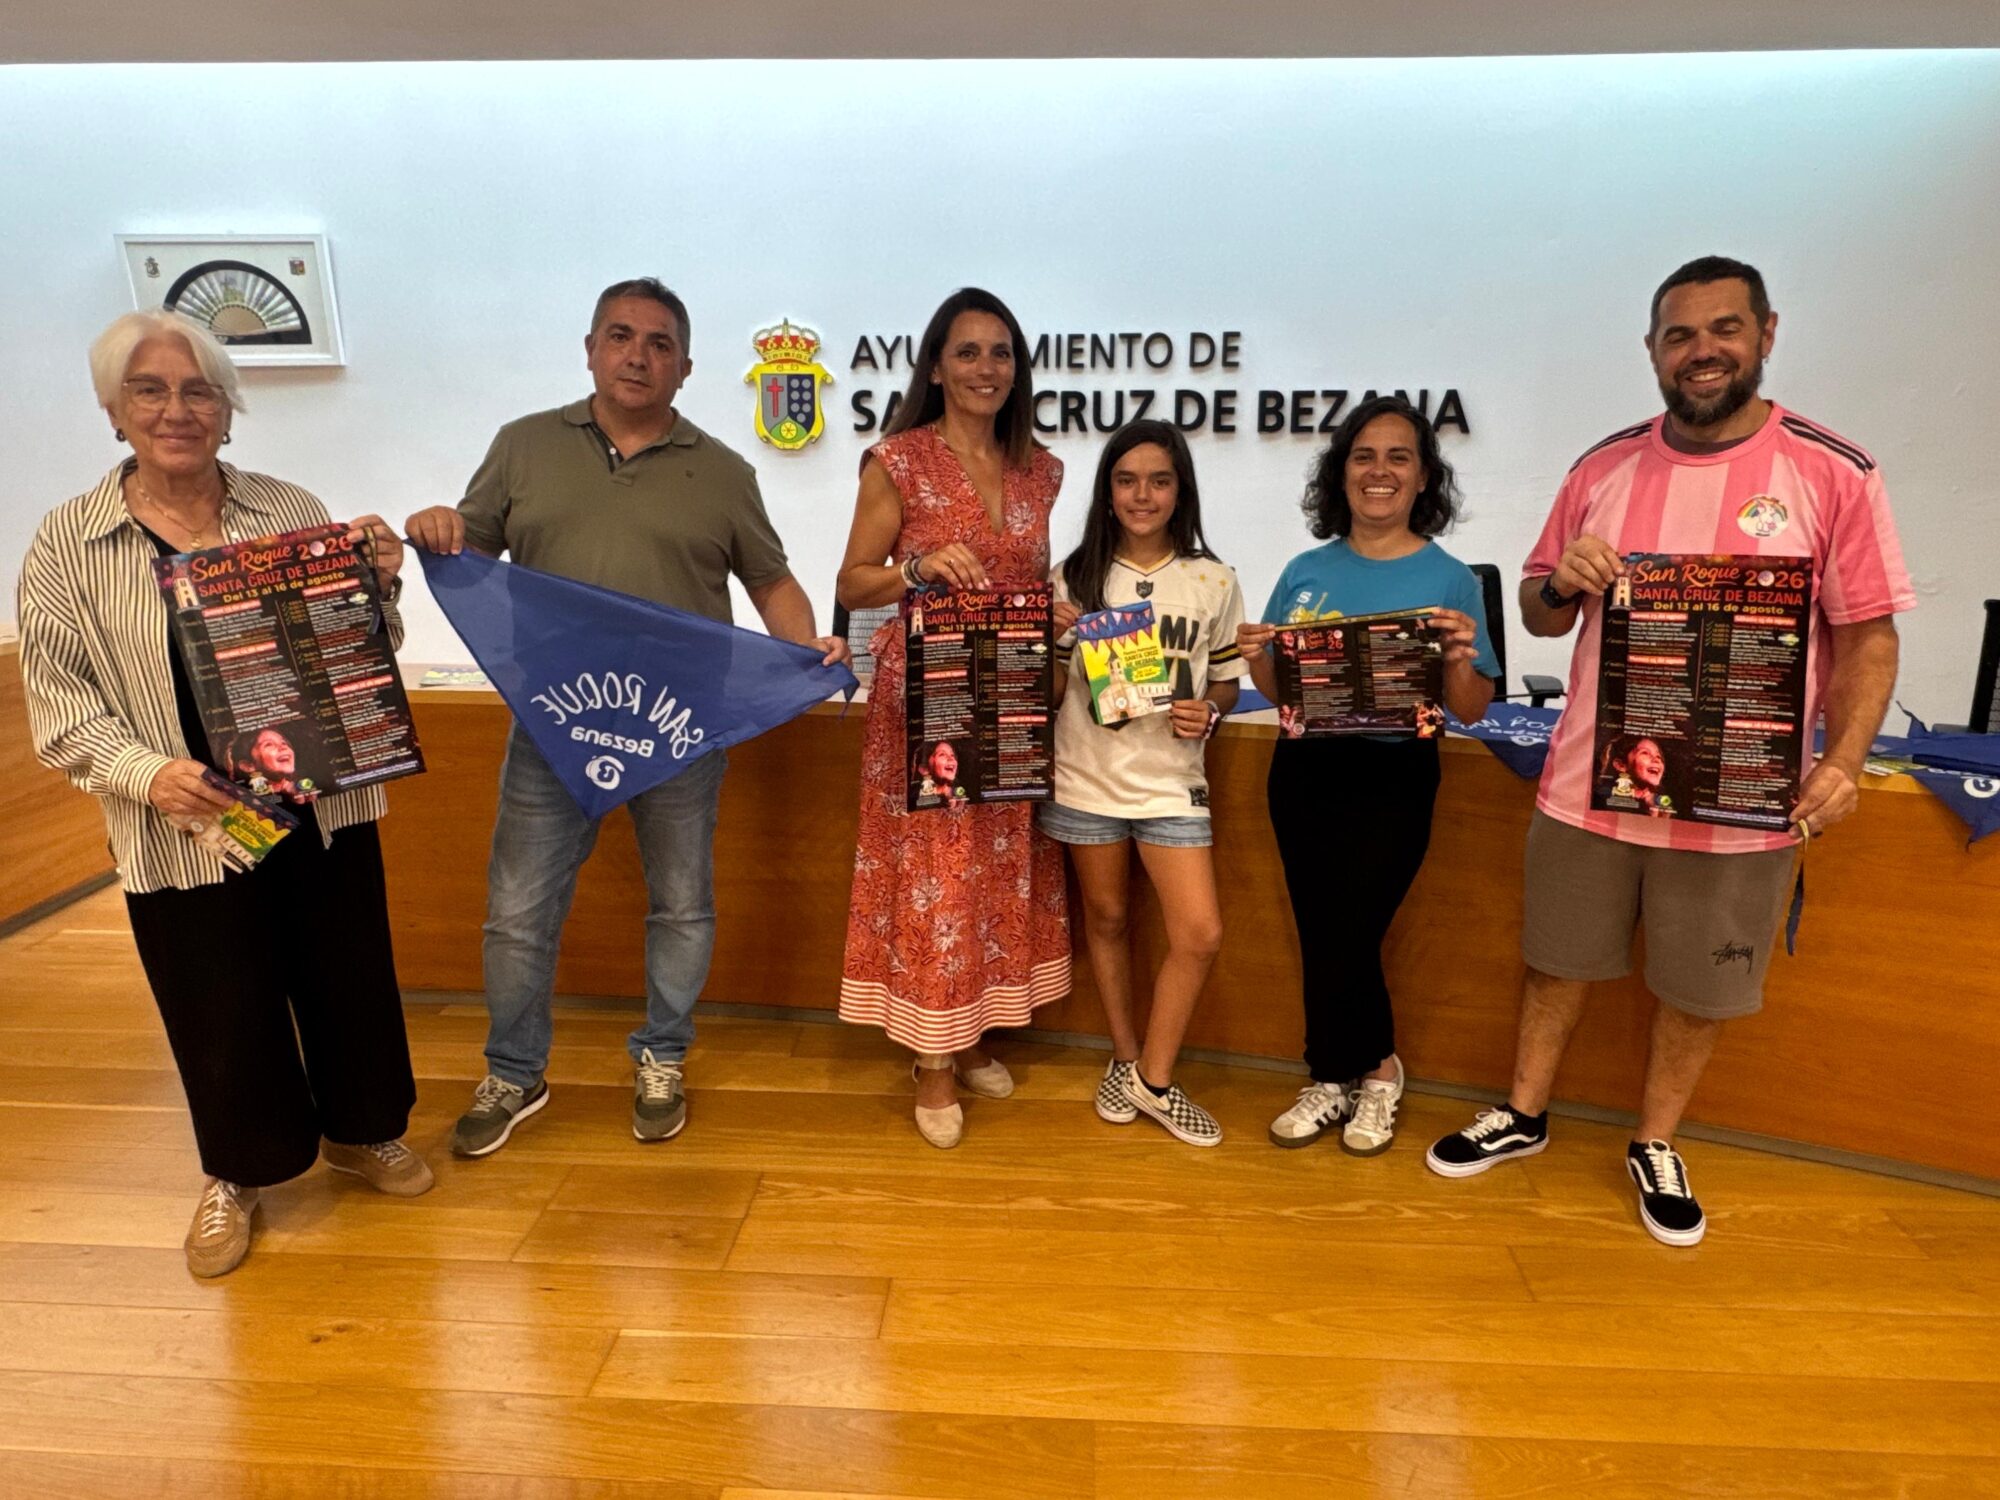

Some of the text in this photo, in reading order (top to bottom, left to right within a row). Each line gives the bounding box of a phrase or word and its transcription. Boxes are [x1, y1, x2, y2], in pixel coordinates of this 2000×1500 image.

[850, 331, 1241, 370] AYUMIENTO DE
[1032, 389, 1470, 434] CRUZ DE BEZNA
[191, 557, 236, 582] San
[237, 546, 294, 574] Roque
[199, 578, 245, 598] SANTA
[248, 570, 284, 587] CRUZ
[287, 566, 305, 580] DE
[307, 554, 359, 576] BEZANA
[1632, 560, 1805, 589] San Roque 2026
[223, 591, 243, 603] Del
[247, 588, 259, 598] 13
[261, 585, 272, 596] al
[274, 582, 287, 593] 16
[290, 579, 304, 589] de
[307, 571, 345, 586] agosto
[923, 591, 1048, 612] San Roque 2026
[1633, 588, 1803, 606] SANTA CRUZ DE BEZANA
[925, 611, 1048, 625] SANTA CRUZ DE BEZANA
[1653, 602, 1785, 615] Del 13 al 16 de agosto
[1003, 623, 1035, 631] agosto
